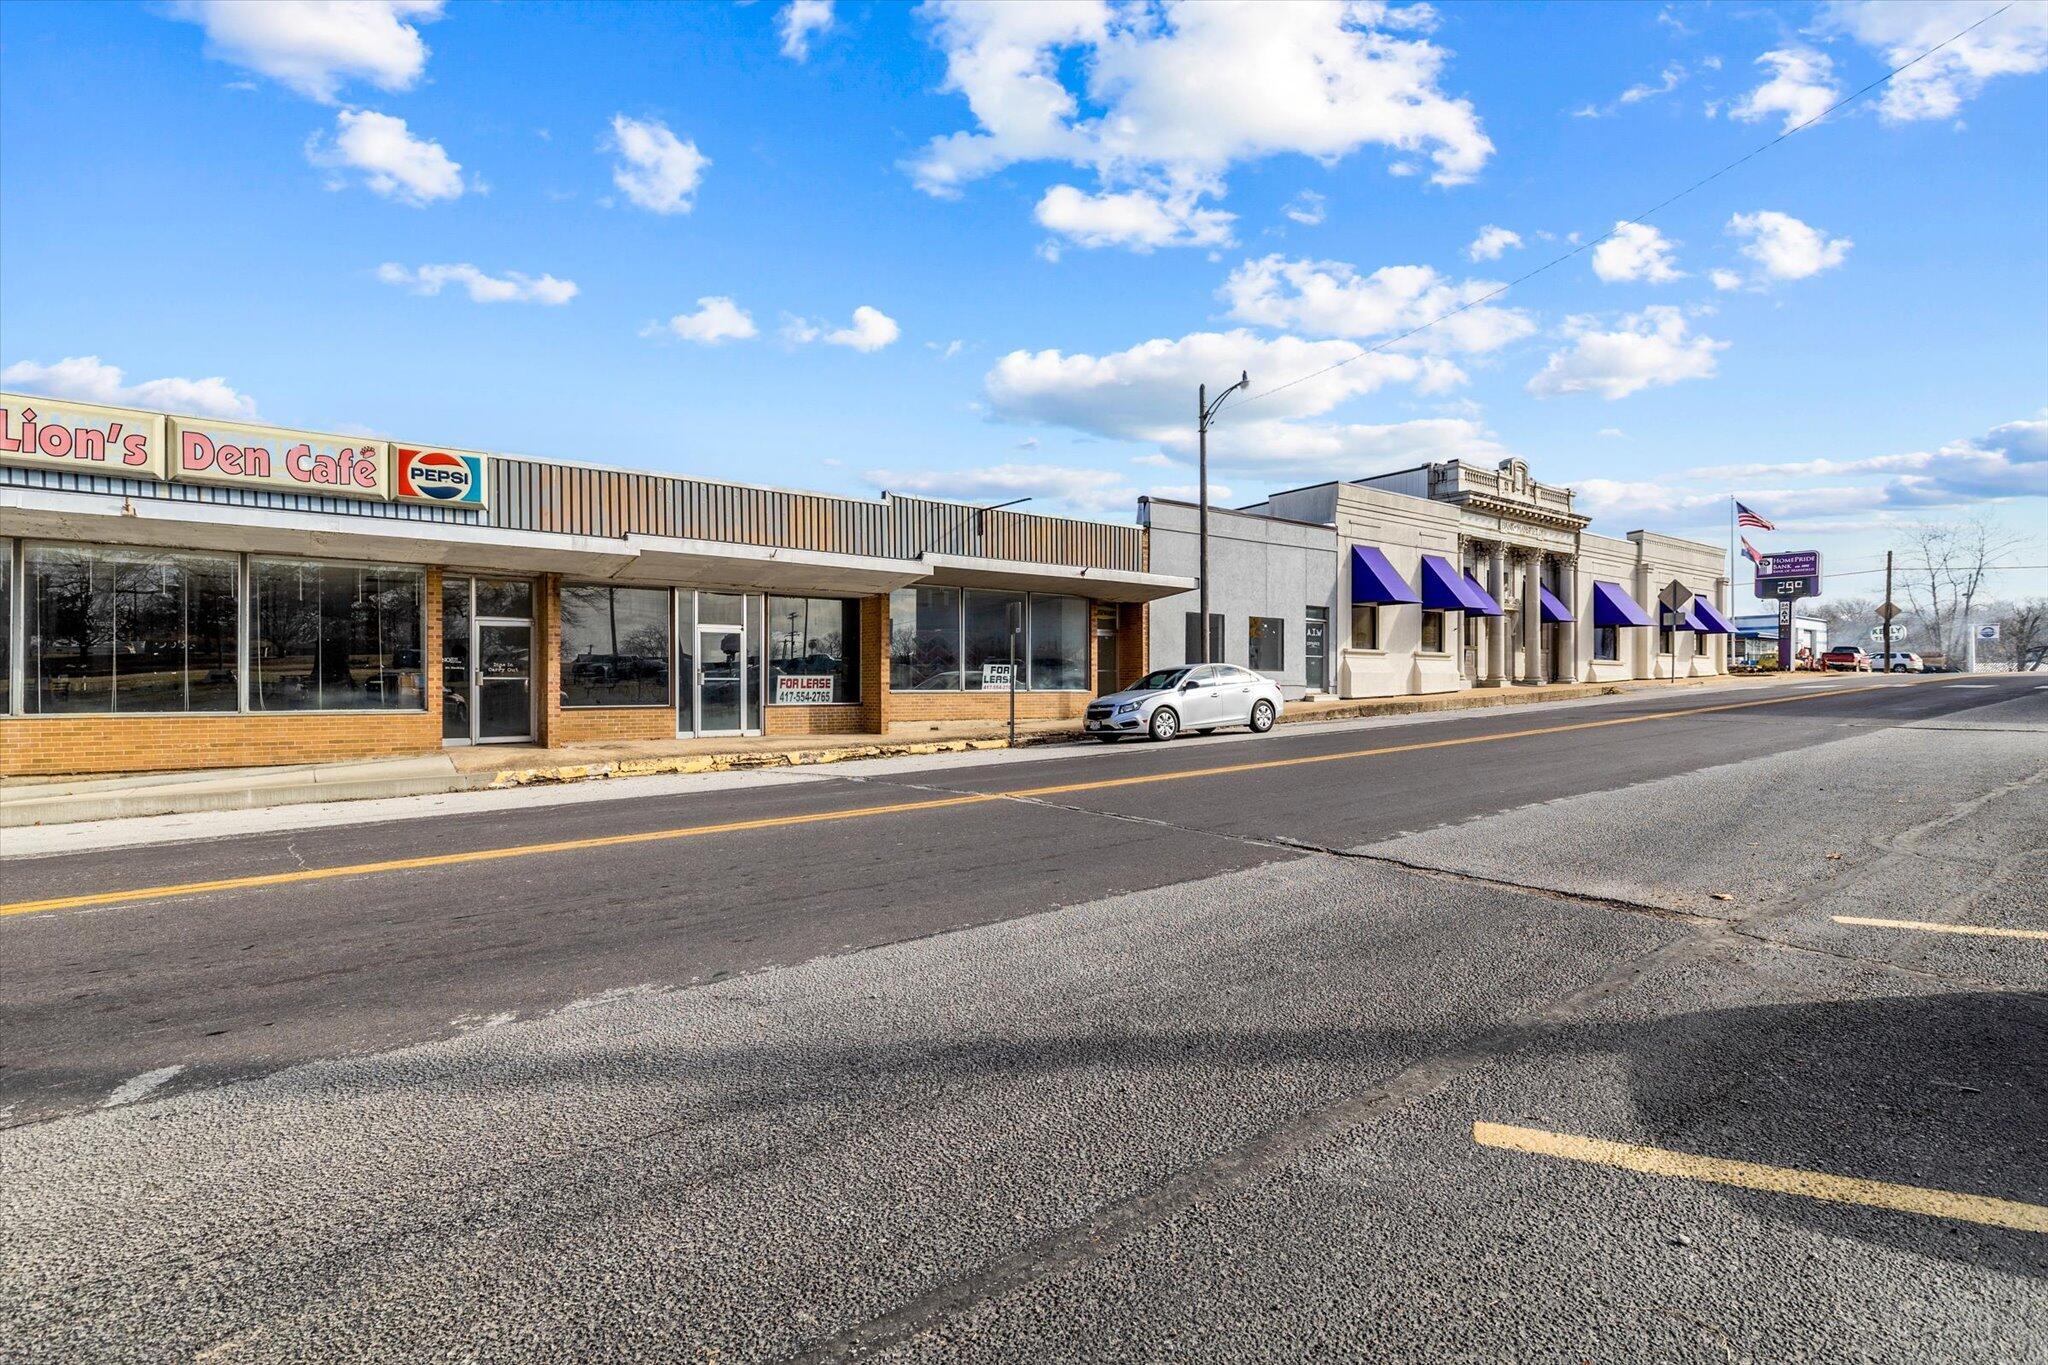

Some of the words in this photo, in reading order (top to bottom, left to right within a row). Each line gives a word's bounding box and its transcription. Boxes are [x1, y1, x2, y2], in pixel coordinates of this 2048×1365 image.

[0, 408, 148, 466] Lion's
[182, 431, 271, 477] Den
[411, 467, 469, 485] PEPSI
[1872, 626, 1902, 635] KELY
[990, 666, 1010, 674] FOR
[780, 678, 799, 689] FOR
[800, 678, 831, 689] LEASE
[780, 691, 831, 702] 417-554-2765
